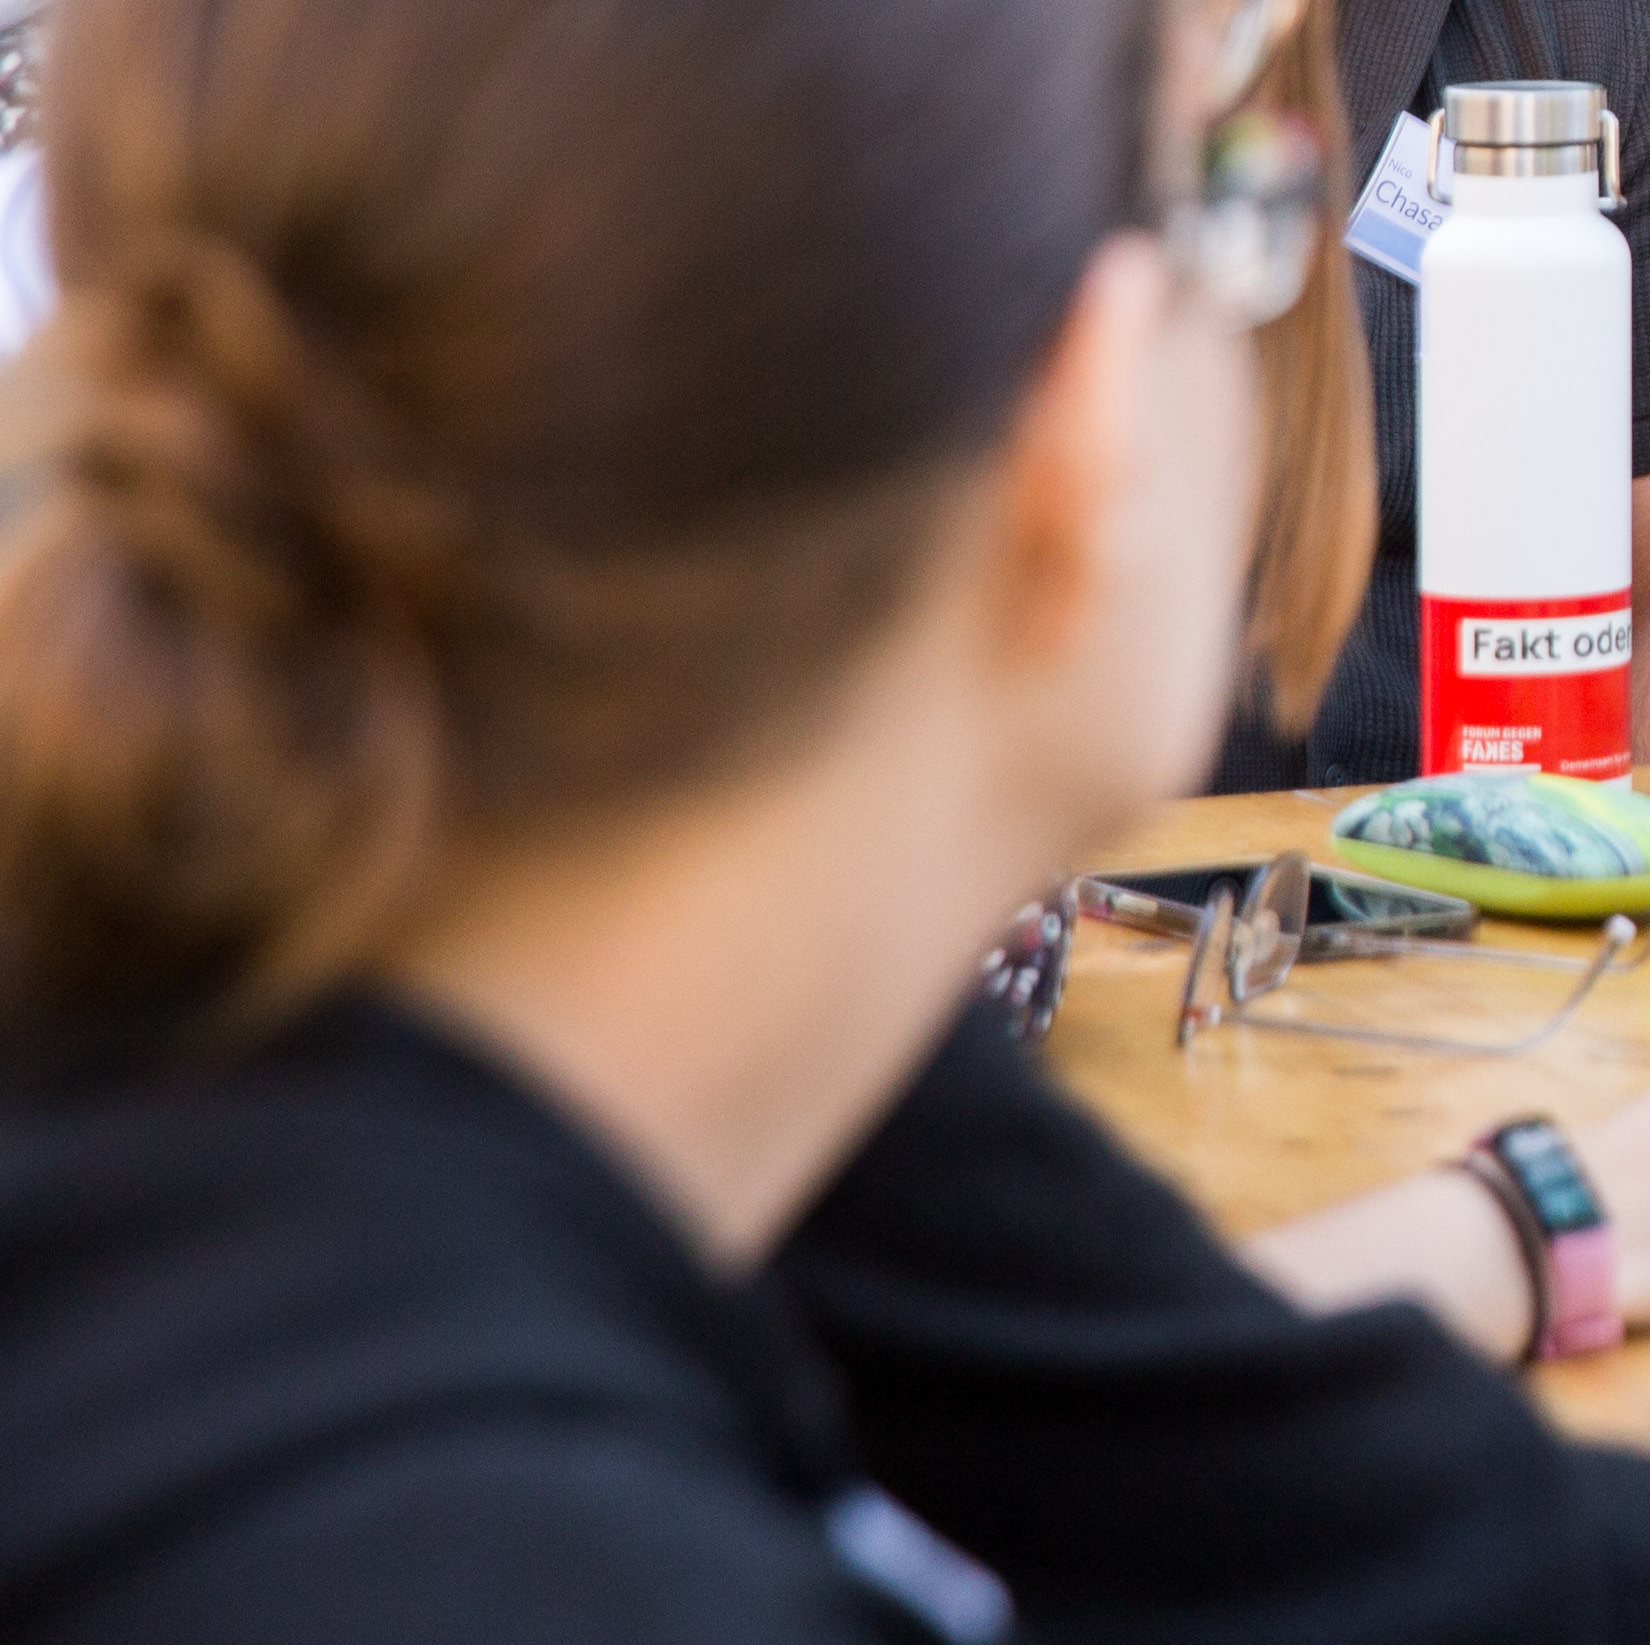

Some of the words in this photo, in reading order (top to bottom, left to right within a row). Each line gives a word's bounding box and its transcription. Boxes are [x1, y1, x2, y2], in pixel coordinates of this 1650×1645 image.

[1388, 159, 1412, 179] Nico
[1376, 180, 1444, 232] Chasa
[1473, 628, 1561, 662] Fakt
[1463, 726, 1500, 739] FORUM
[1502, 726, 1542, 740] GEGEN
[1463, 740, 1523, 762] FAKES
